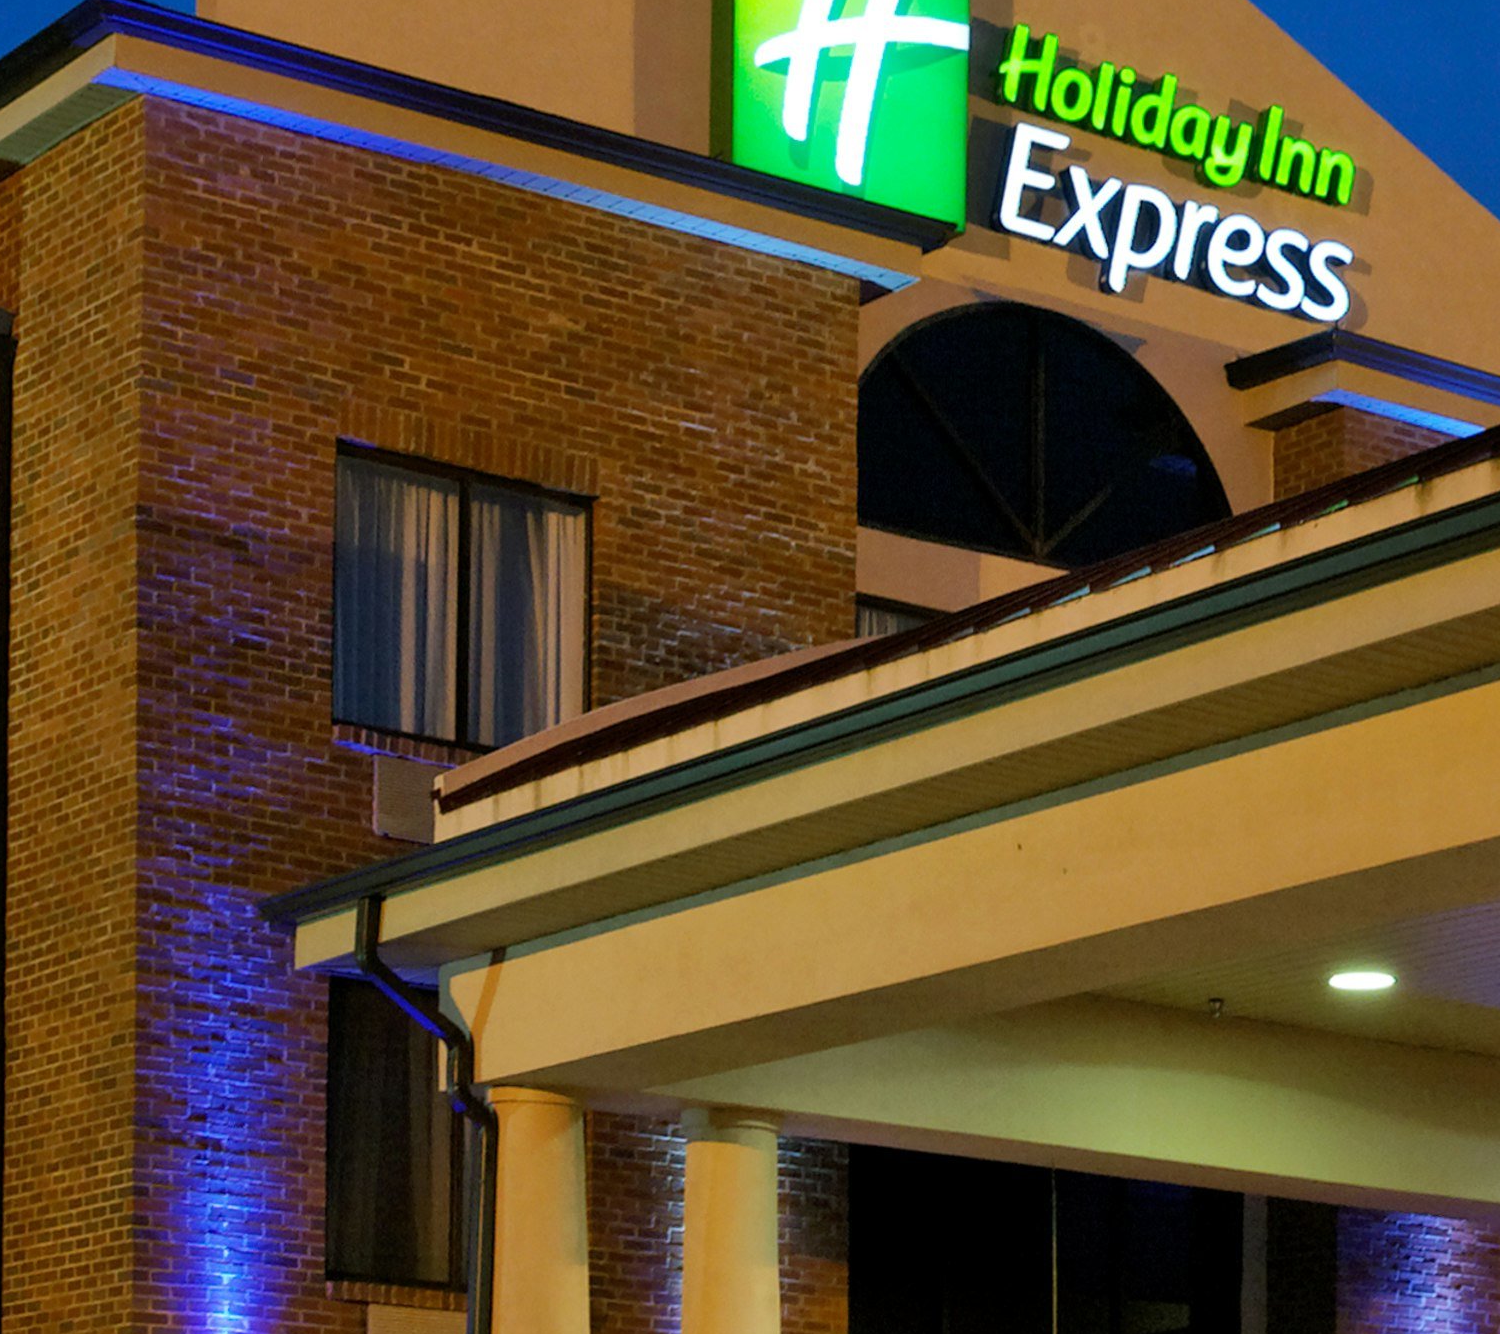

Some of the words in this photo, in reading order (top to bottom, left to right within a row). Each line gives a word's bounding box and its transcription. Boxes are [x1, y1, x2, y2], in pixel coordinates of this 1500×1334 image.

[999, 24, 1253, 187] Holiday
[1259, 105, 1356, 205] Inn
[1000, 122, 1354, 322] Express
